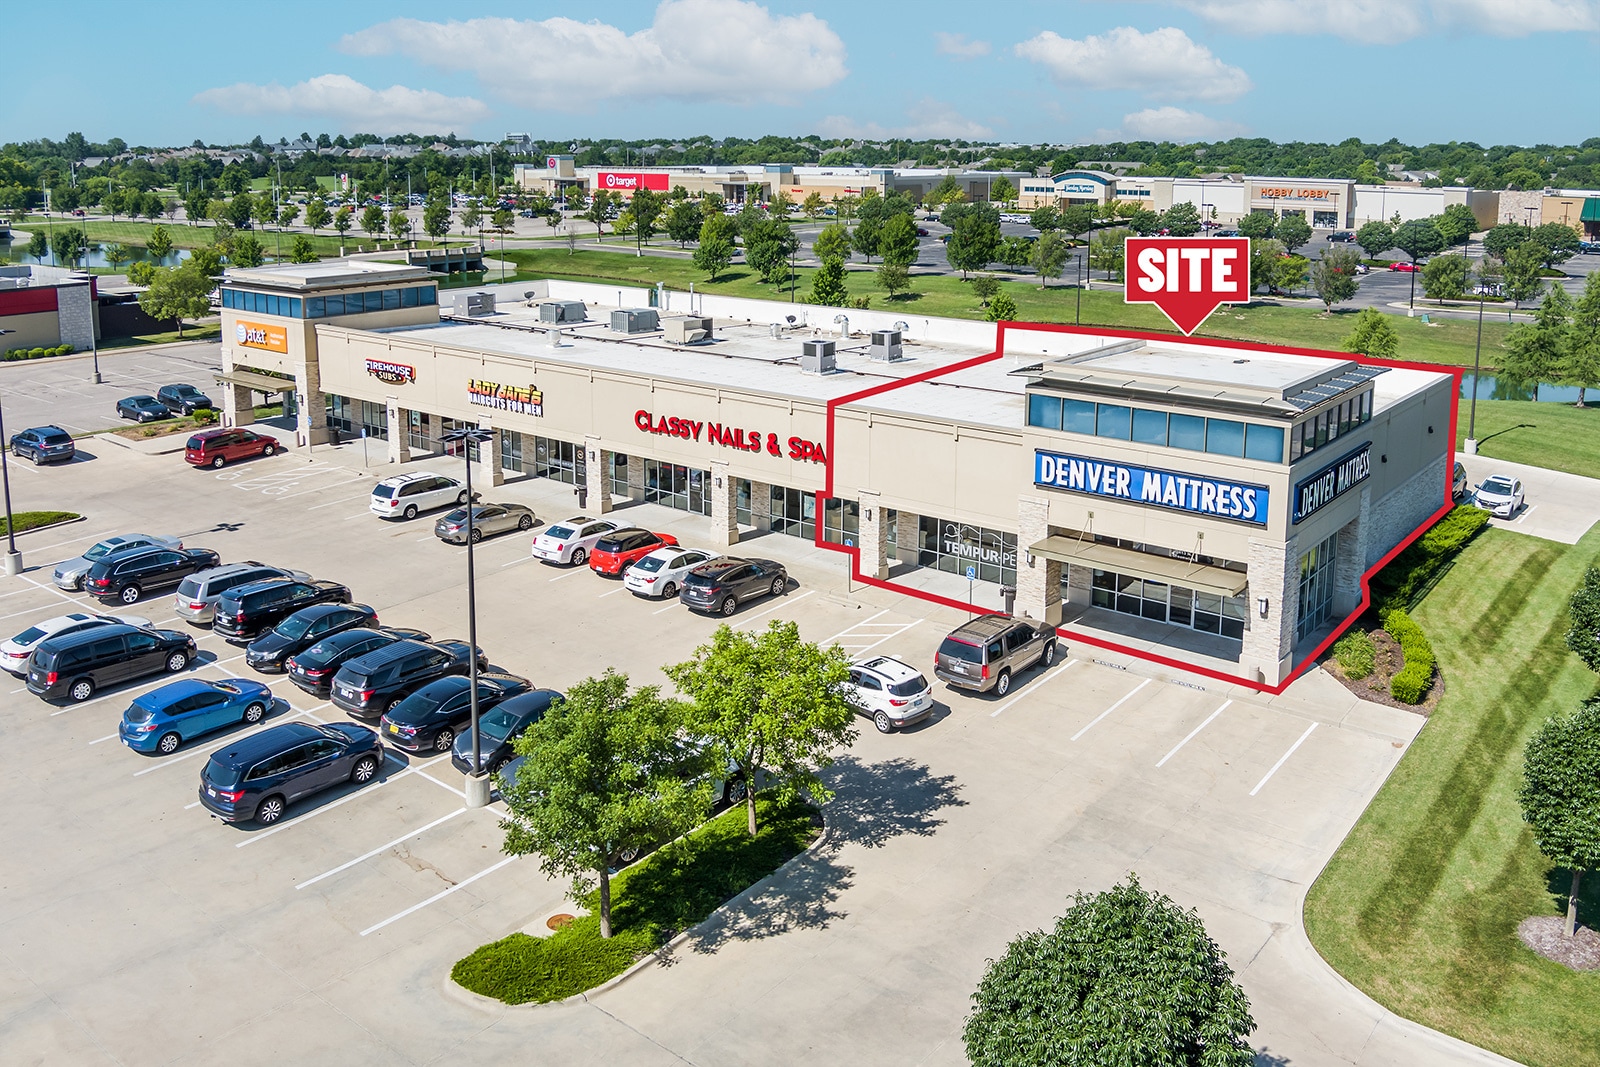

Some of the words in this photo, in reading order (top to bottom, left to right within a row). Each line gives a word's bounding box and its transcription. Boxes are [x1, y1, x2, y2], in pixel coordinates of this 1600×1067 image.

[616, 176, 637, 188] target
[1260, 187, 1293, 197] HOBBY
[1297, 189, 1330, 199] LOBBY
[247, 328, 267, 344] at&t
[365, 360, 412, 380] FIREHOUSE
[378, 371, 397, 381] SUBS
[467, 379, 500, 396] LADY
[499, 384, 543, 405] JANE'S
[467, 392, 507, 410] HAIRCUTS
[506, 399, 524, 413] FOR
[524, 403, 543, 416] MEN
[767, 433, 782, 458] &
[1041, 455, 1131, 497] DENVER
[1141, 471, 1257, 519] MATTRESS
[1301, 471, 1335, 517] DENVER
[1337, 449, 1371, 494] MATTRESS
